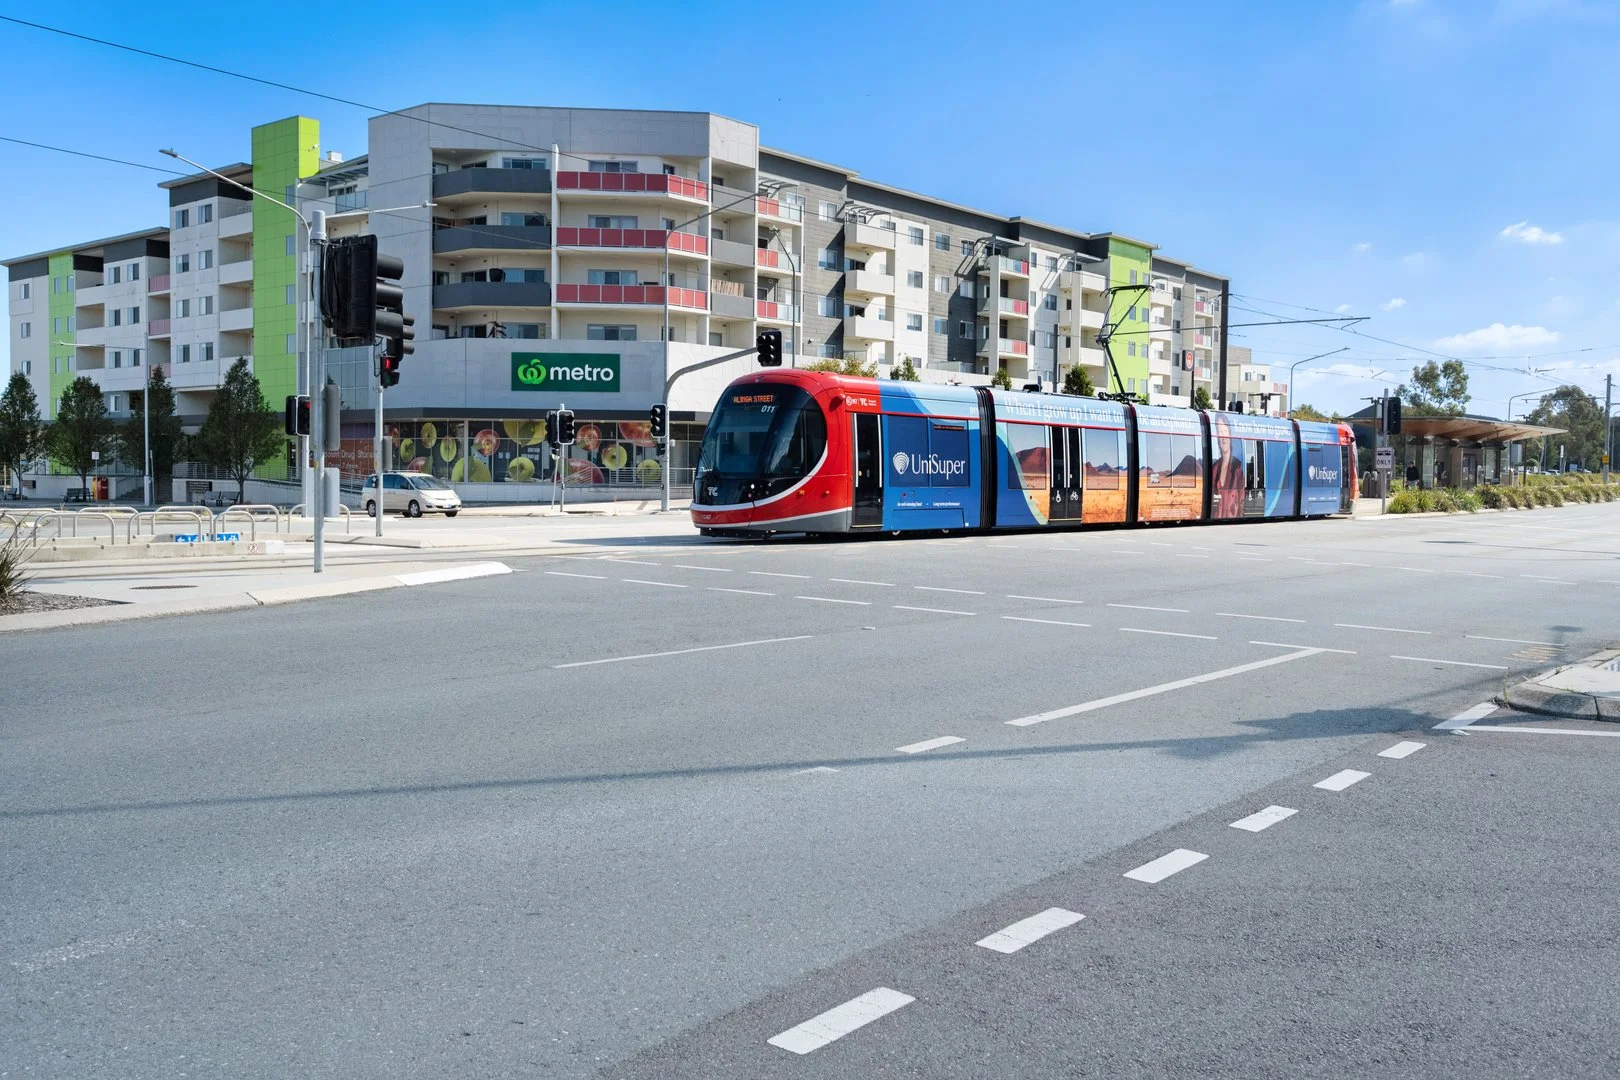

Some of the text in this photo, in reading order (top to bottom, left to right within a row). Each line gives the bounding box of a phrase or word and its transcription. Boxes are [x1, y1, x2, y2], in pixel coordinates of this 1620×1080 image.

[549, 363, 614, 382] metro
[754, 394, 774, 403] STREET
[761, 404, 776, 413] 011
[1004, 396, 1035, 417] When
[1037, 400, 1042, 416] I
[1044, 403, 1068, 422] grow
[1069, 407, 1083, 424] up
[1084, 404, 1088, 420] I
[1089, 407, 1113, 422] want
[1113, 409, 1123, 424] to
[1138, 411, 1149, 425] be
[1150, 414, 1161, 426] an
[1233, 419, 1253, 433] Know
[1253, 419, 1267, 434] how
[1267, 423, 1274, 435] to
[911, 453, 966, 480] UniSuper
[1315, 466, 1338, 483] UniSuper
[707, 486, 719, 497] TC
